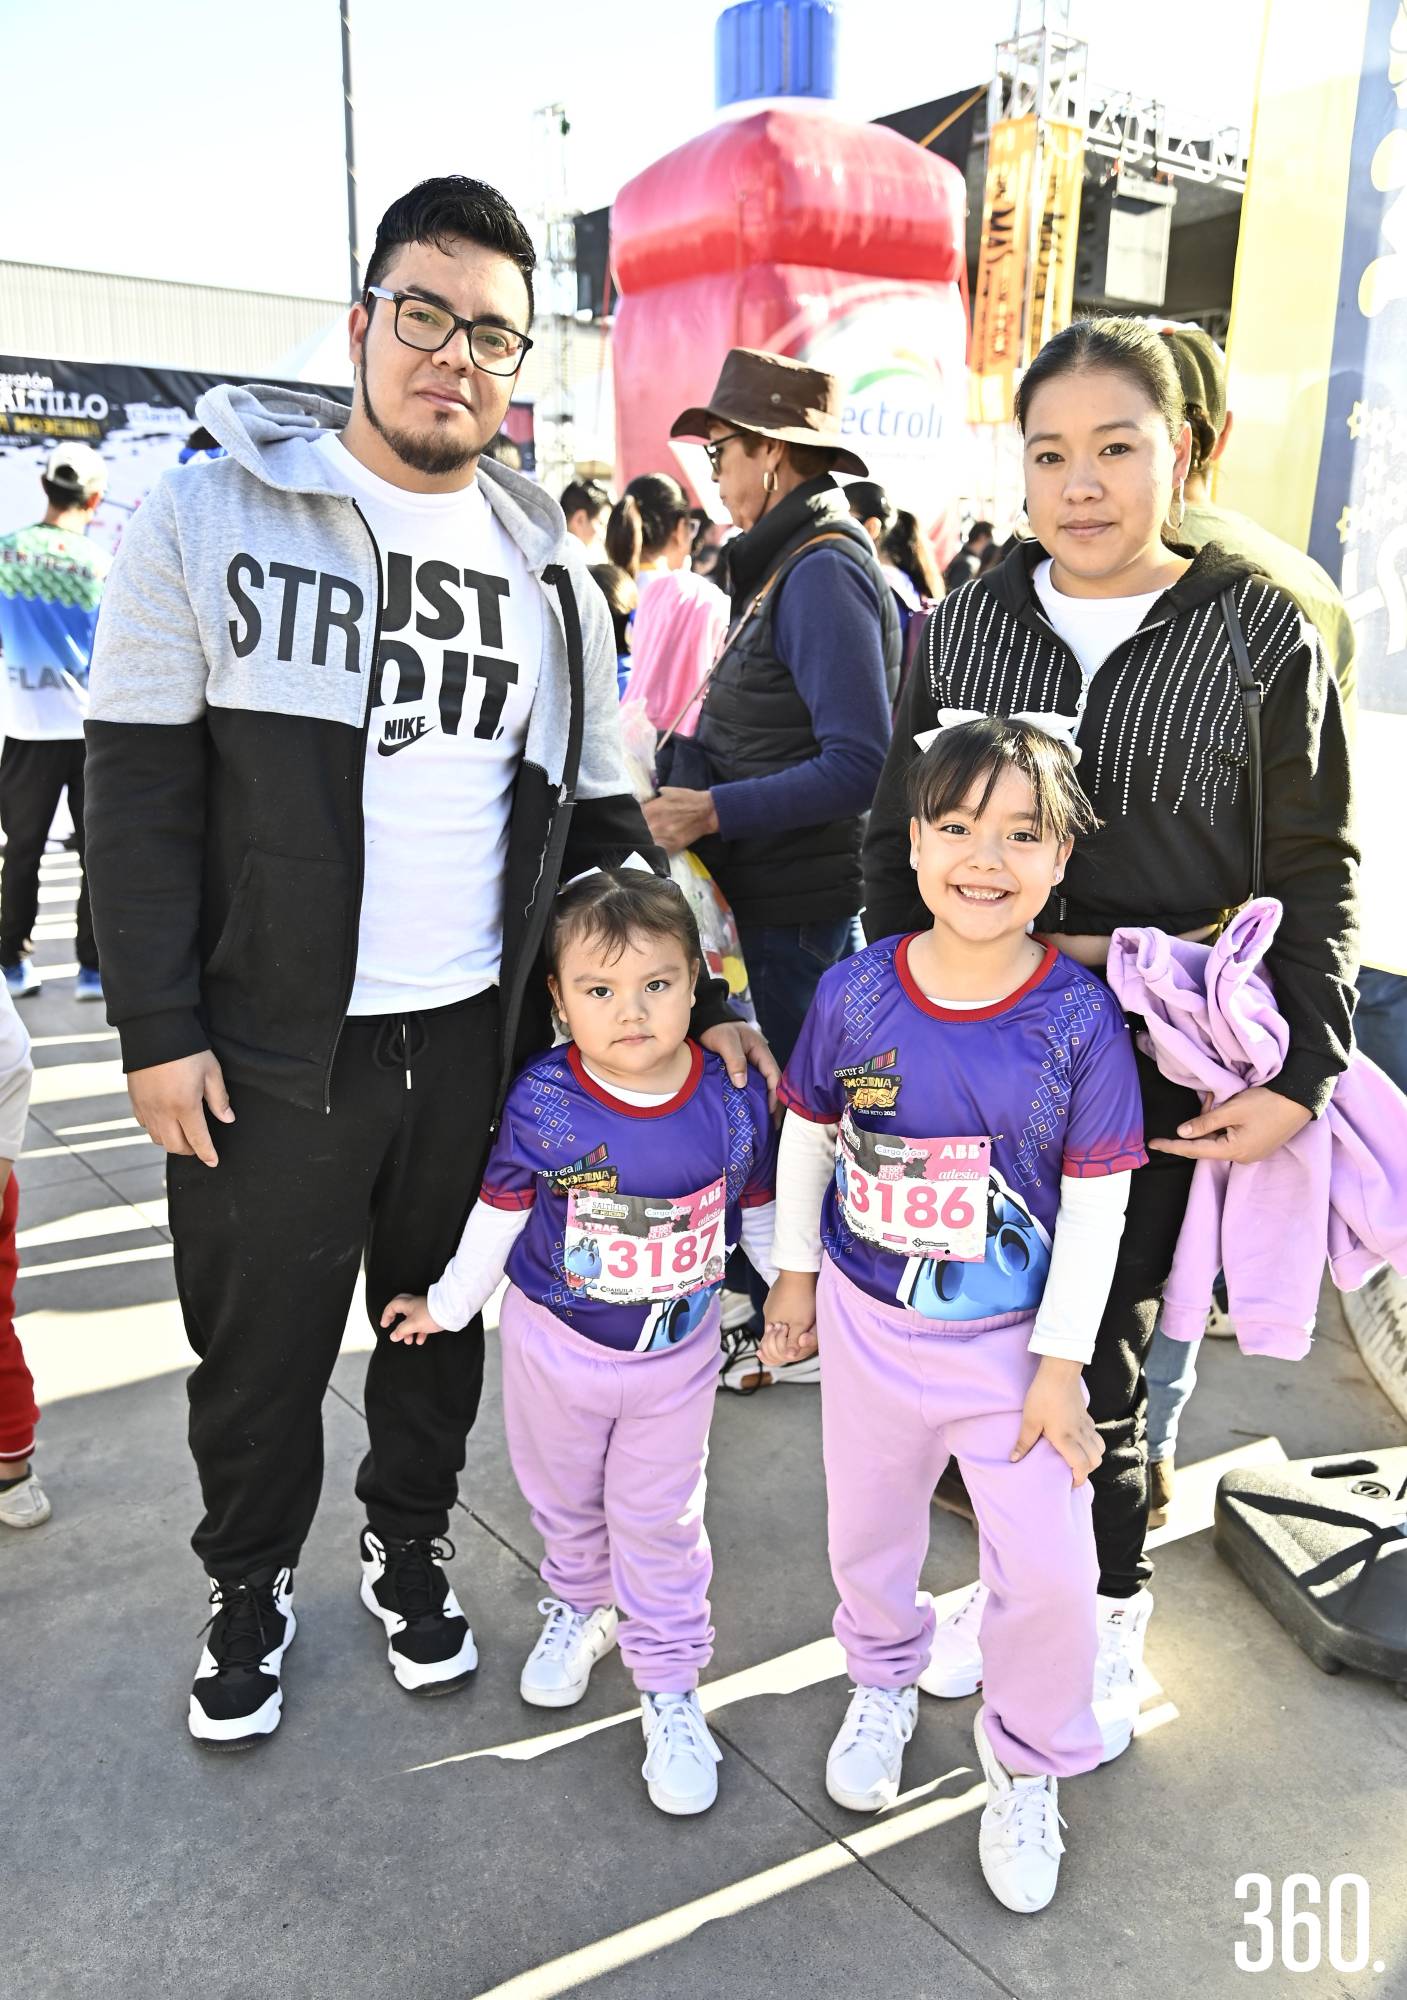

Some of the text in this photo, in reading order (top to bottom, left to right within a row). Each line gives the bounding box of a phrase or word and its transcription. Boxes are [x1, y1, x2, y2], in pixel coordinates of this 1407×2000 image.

[227, 552, 363, 674] STR
[380, 551, 511, 649] JUST
[384, 715, 427, 740] NIKE
[940, 1145, 980, 1160] ABB
[850, 1170, 975, 1230] 3186
[607, 1222, 719, 1279] 3187
